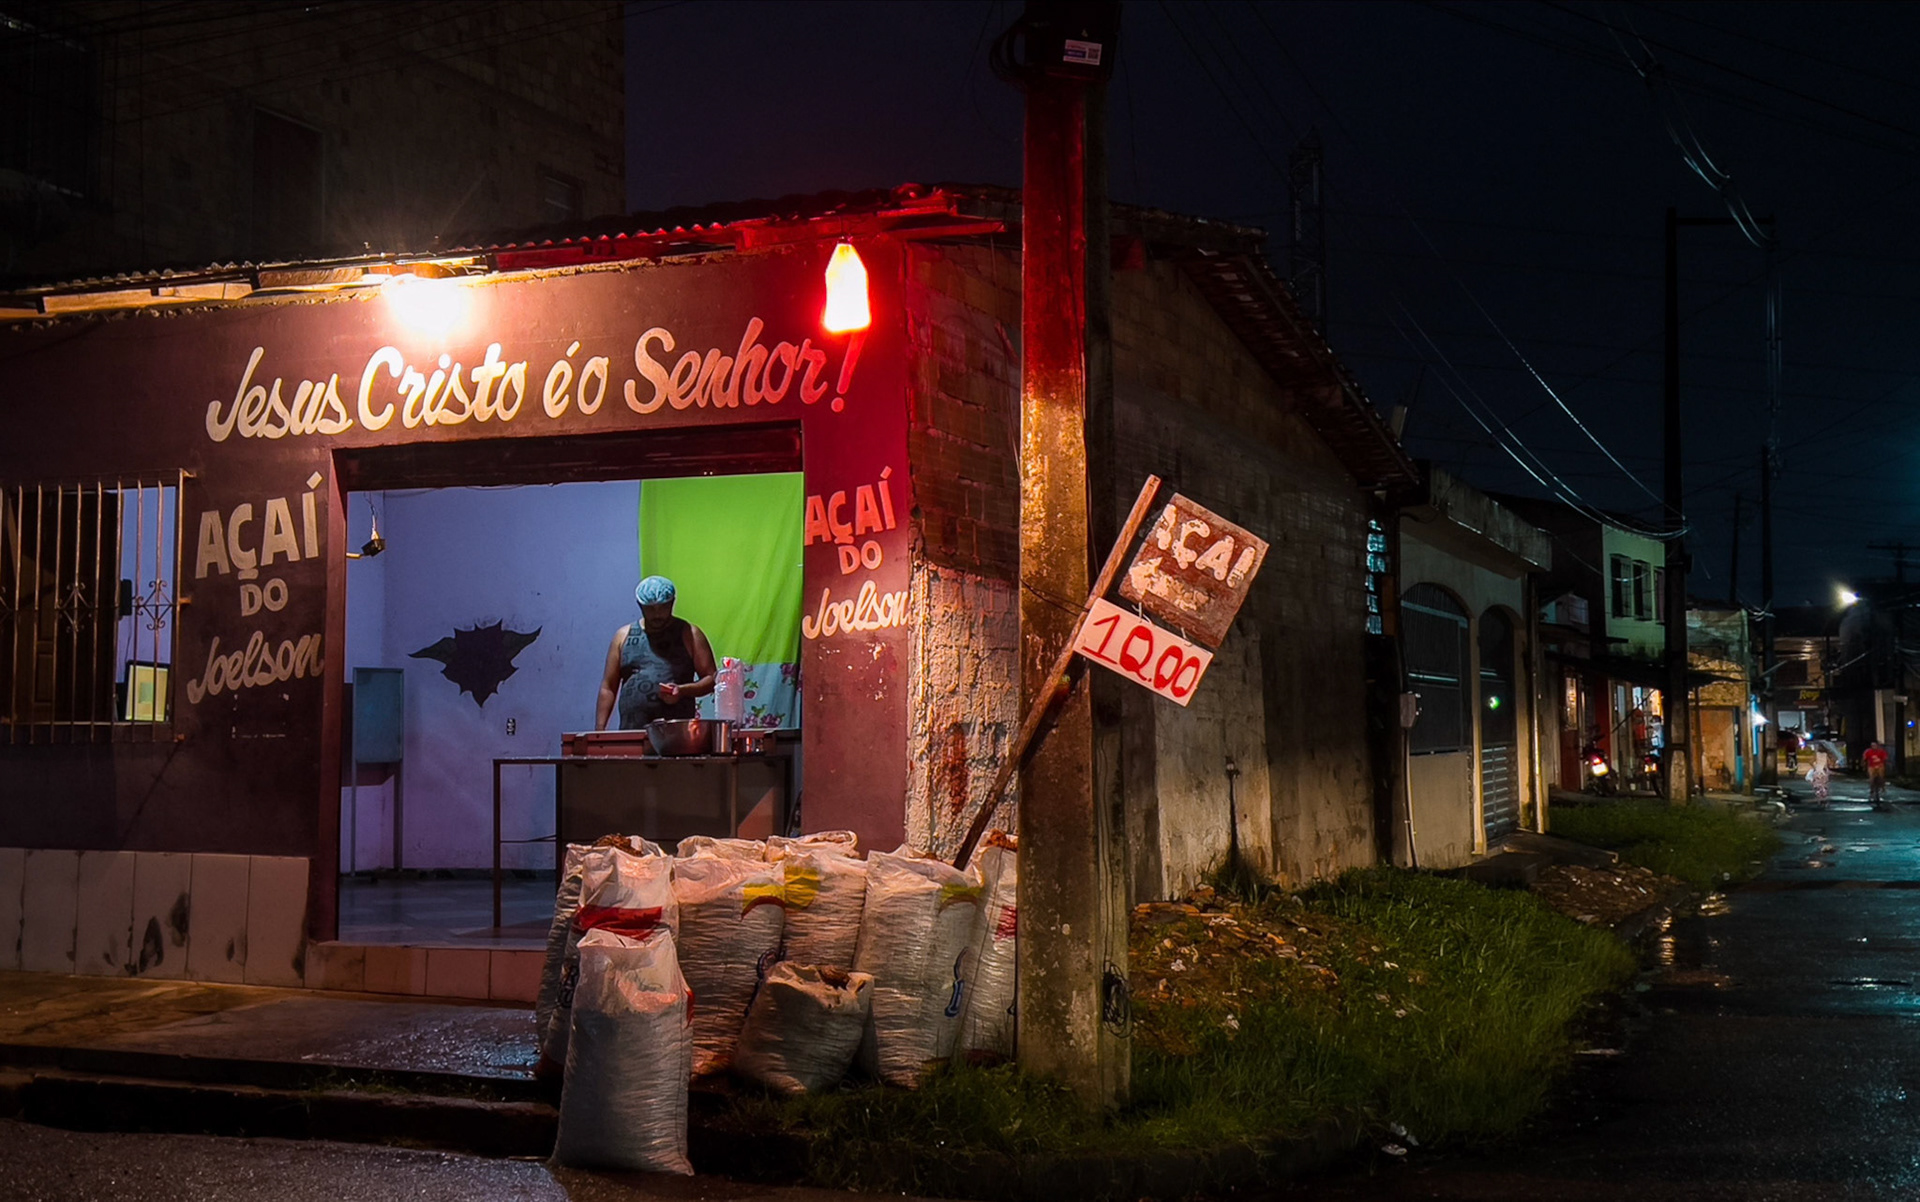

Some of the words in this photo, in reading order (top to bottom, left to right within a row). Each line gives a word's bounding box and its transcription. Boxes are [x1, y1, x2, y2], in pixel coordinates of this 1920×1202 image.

[206, 346, 353, 442] Jesus
[357, 342, 527, 431] Cristo
[195, 470, 323, 580] AÇAÍ
[804, 465, 897, 546] AÇAÍ
[838, 540, 883, 575] DO
[240, 577, 288, 616] DO
[801, 580, 912, 640] Joelson
[187, 630, 325, 704] Joelson
